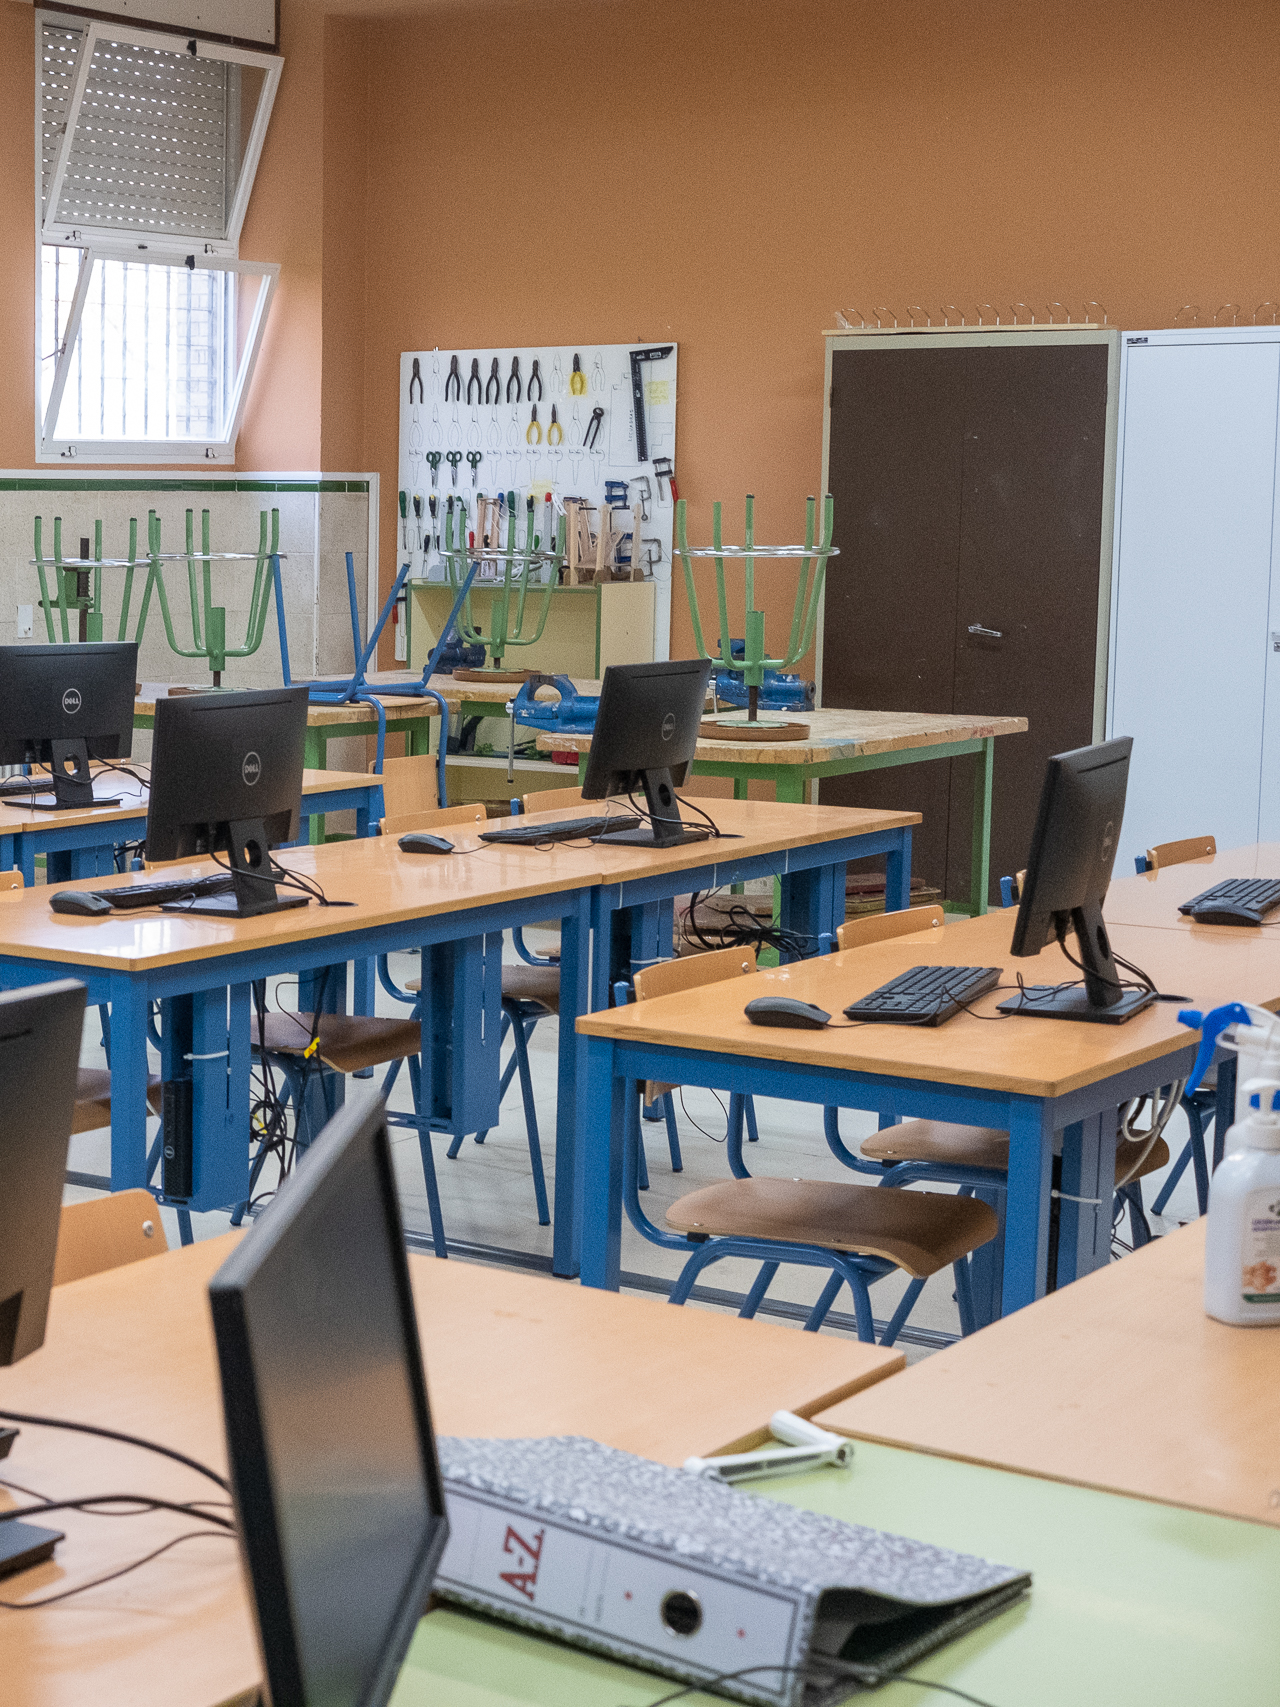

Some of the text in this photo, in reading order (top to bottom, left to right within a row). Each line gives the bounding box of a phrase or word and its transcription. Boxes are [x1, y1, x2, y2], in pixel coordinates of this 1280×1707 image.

[64, 697, 80, 705] DELL
[244, 763, 259, 773] DELL
[499, 1525, 545, 1601] A-Z
